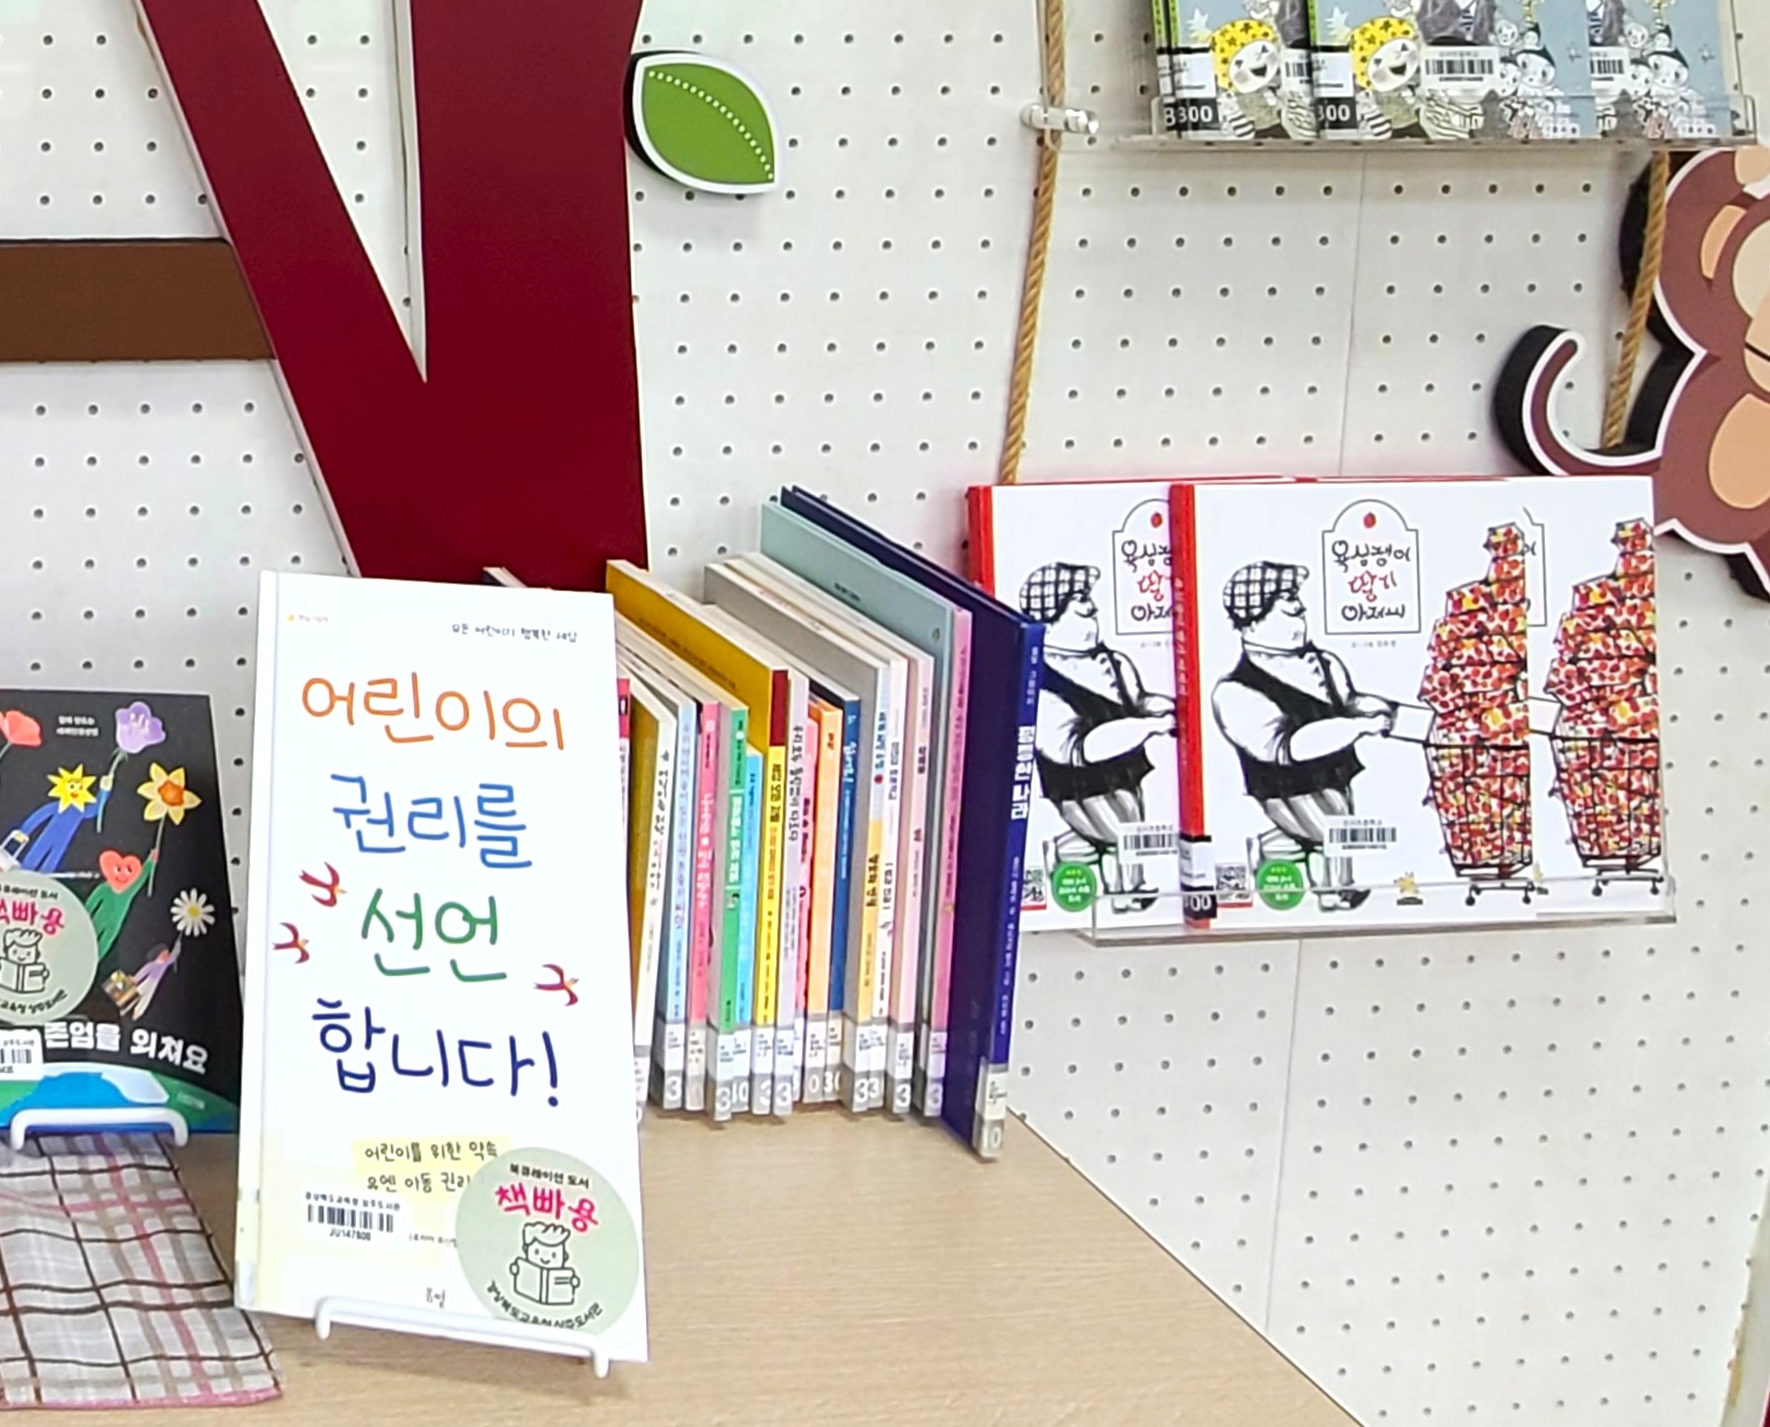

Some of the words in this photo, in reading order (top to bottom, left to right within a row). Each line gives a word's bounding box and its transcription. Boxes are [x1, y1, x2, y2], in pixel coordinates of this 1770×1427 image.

[1331, 539, 1412, 572] 욕심쟁이
[1348, 571, 1397, 602] 딸기
[452, 623, 470, 634] 모든
[1341, 603, 1406, 622] 아저씨
[302, 671, 565, 752] 어린이의
[331, 774, 533, 869] 권리를
[361, 887, 508, 984] 선언
[43, 1021, 121, 1052] 존엄을
[130, 1026, 209, 1074] 외쳐요
[312, 997, 560, 1108] 합니다!
[365, 1141, 422, 1163] 어린이를
[430, 1141, 462, 1162] 위한
[468, 1140, 499, 1161] 약속
[366, 1174, 398, 1193] 유엔
[404, 1172, 433, 1193] 아동
[509, 1162, 565, 1185] 북큐레이션
[567, 1174, 590, 1190] 도서
[495, 1183, 599, 1234] 책빠용
